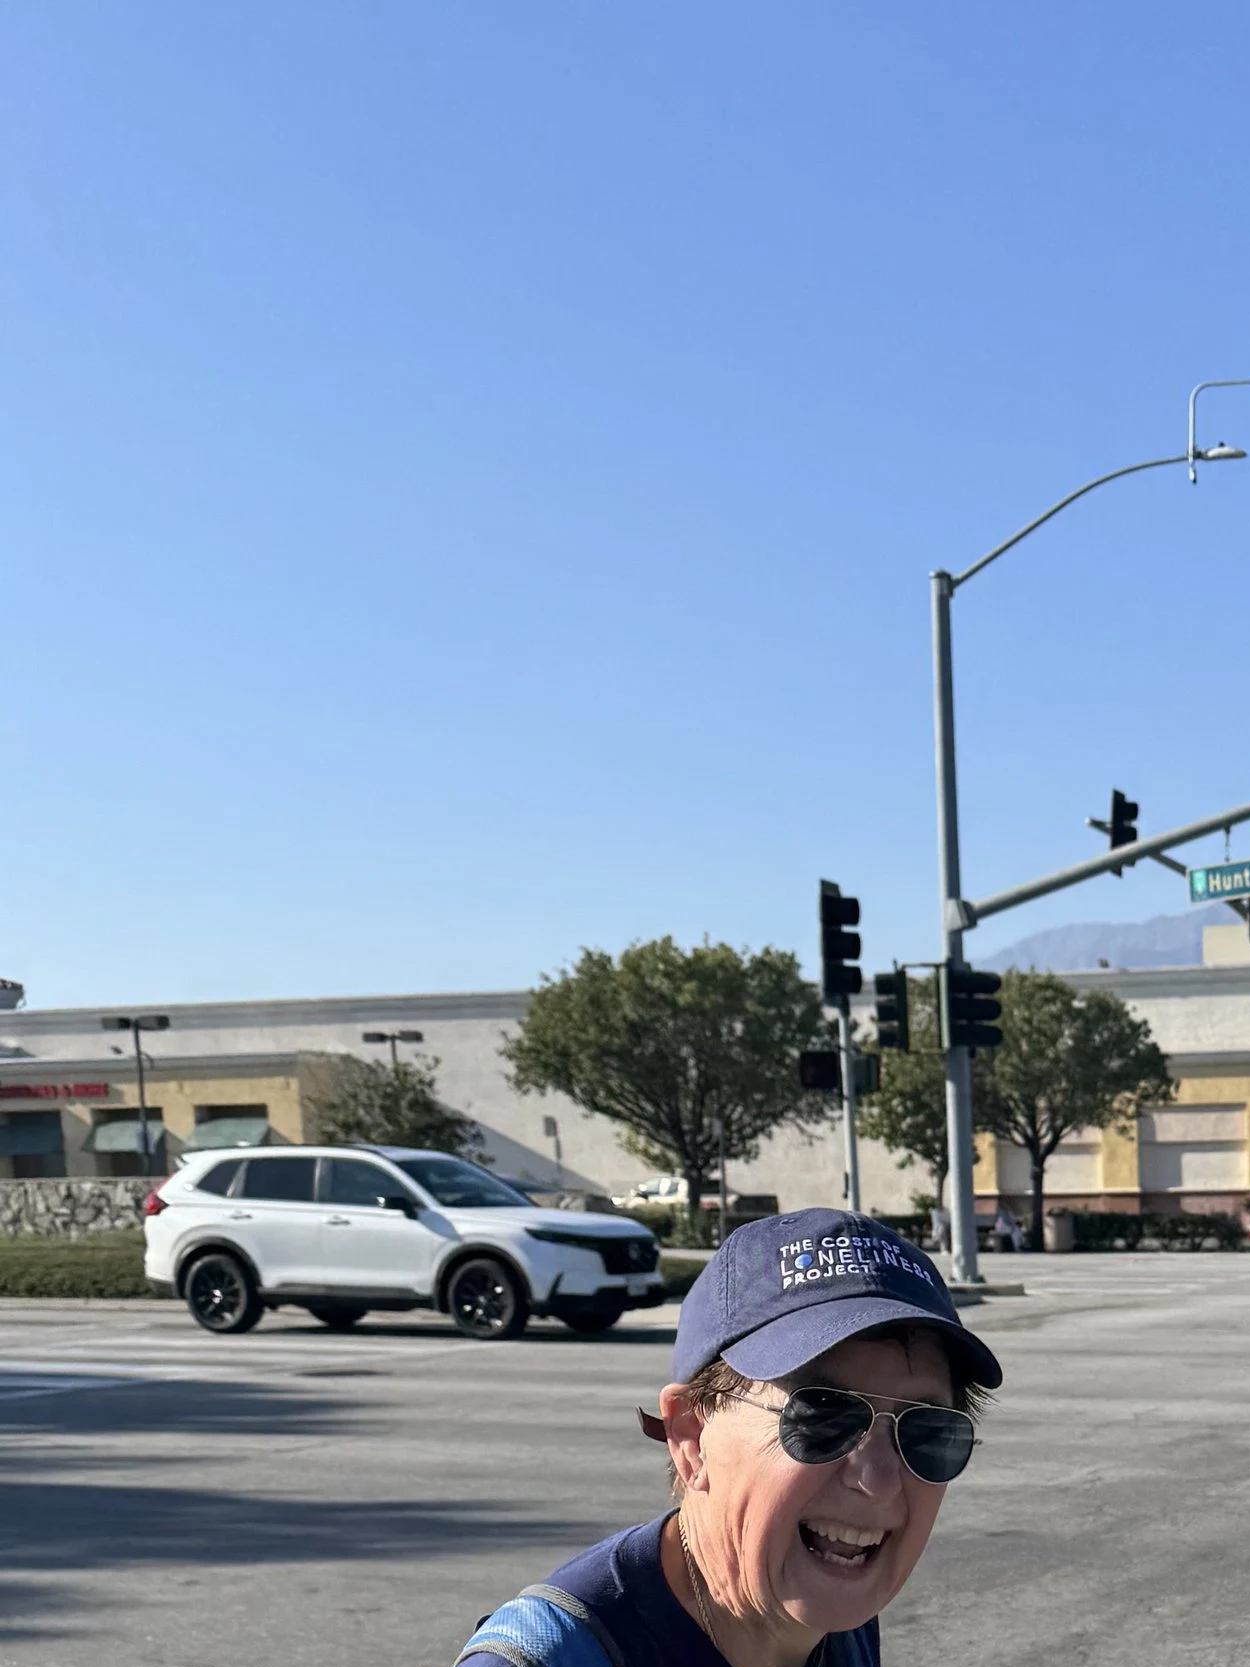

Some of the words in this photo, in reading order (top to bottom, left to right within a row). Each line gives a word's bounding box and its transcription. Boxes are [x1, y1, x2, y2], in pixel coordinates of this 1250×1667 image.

[780, 1239, 813, 1258] THE
[821, 1236, 872, 1249] COST
[880, 1239, 901, 1254] OF
[780, 1249, 935, 1287] LONELINESS
[783, 1264, 870, 1290] PROJECT
